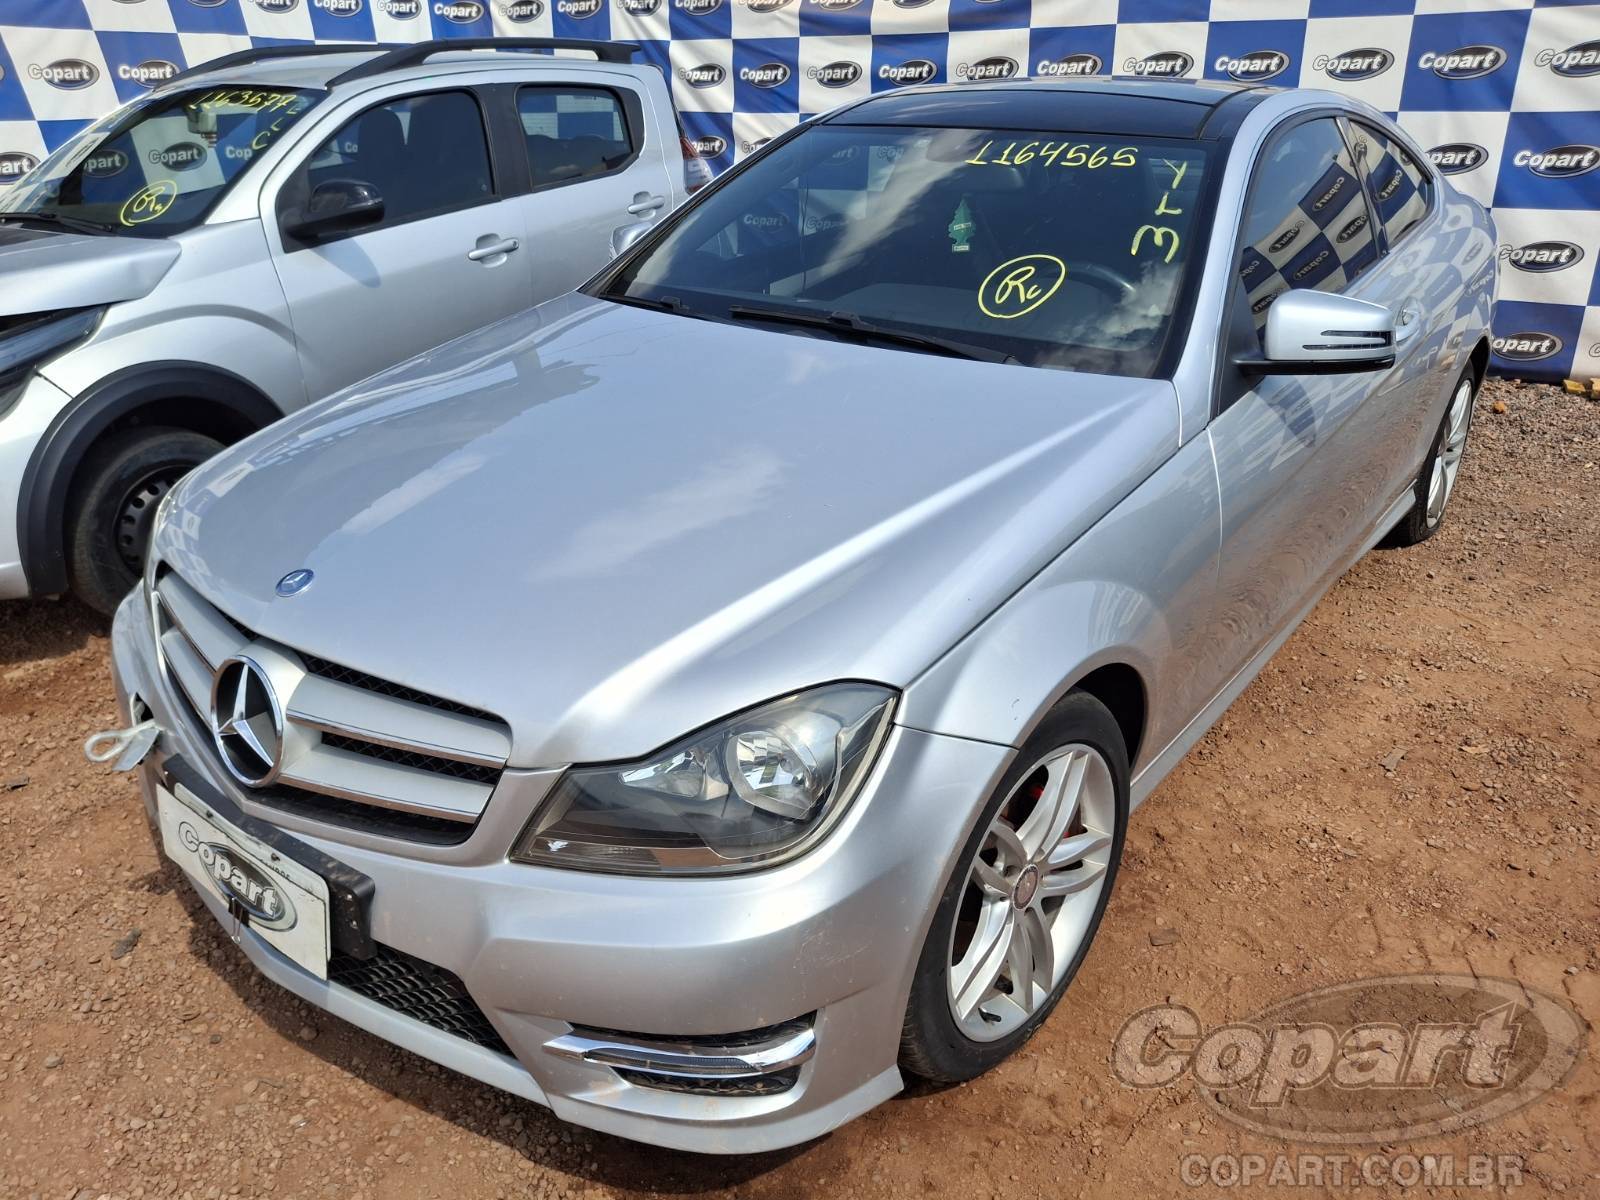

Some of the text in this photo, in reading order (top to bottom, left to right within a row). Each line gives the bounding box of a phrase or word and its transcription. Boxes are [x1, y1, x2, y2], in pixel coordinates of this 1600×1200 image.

[377, 0, 417, 14] Copart
[434, 3, 479, 18] Copart
[499, 3, 537, 18] Copart
[557, 0, 596, 14] Copart
[1122, 57, 1183, 77] Copart
[1214, 55, 1281, 75] Copart
[1312, 53, 1384, 74] Copart
[1418, 50, 1498, 72] Copart
[1534, 48, 1600, 69] Copa
[28, 64, 91, 82] Copart
[118, 65, 176, 82] Copart
[679, 67, 721, 82] Copart
[740, 67, 784, 82] Copart
[807, 63, 856, 81] Copart
[878, 63, 930, 81] Copart
[956, 61, 1011, 80] Copart
[1037, 60, 1094, 76] Copart
[149, 147, 200, 166] Copart
[965, 140, 1139, 169] 1164565
[1514, 148, 1596, 169] Copart
[1499, 244, 1573, 264] Copart
[1491, 337, 1552, 353] opart
[178, 820, 281, 919] Copart
